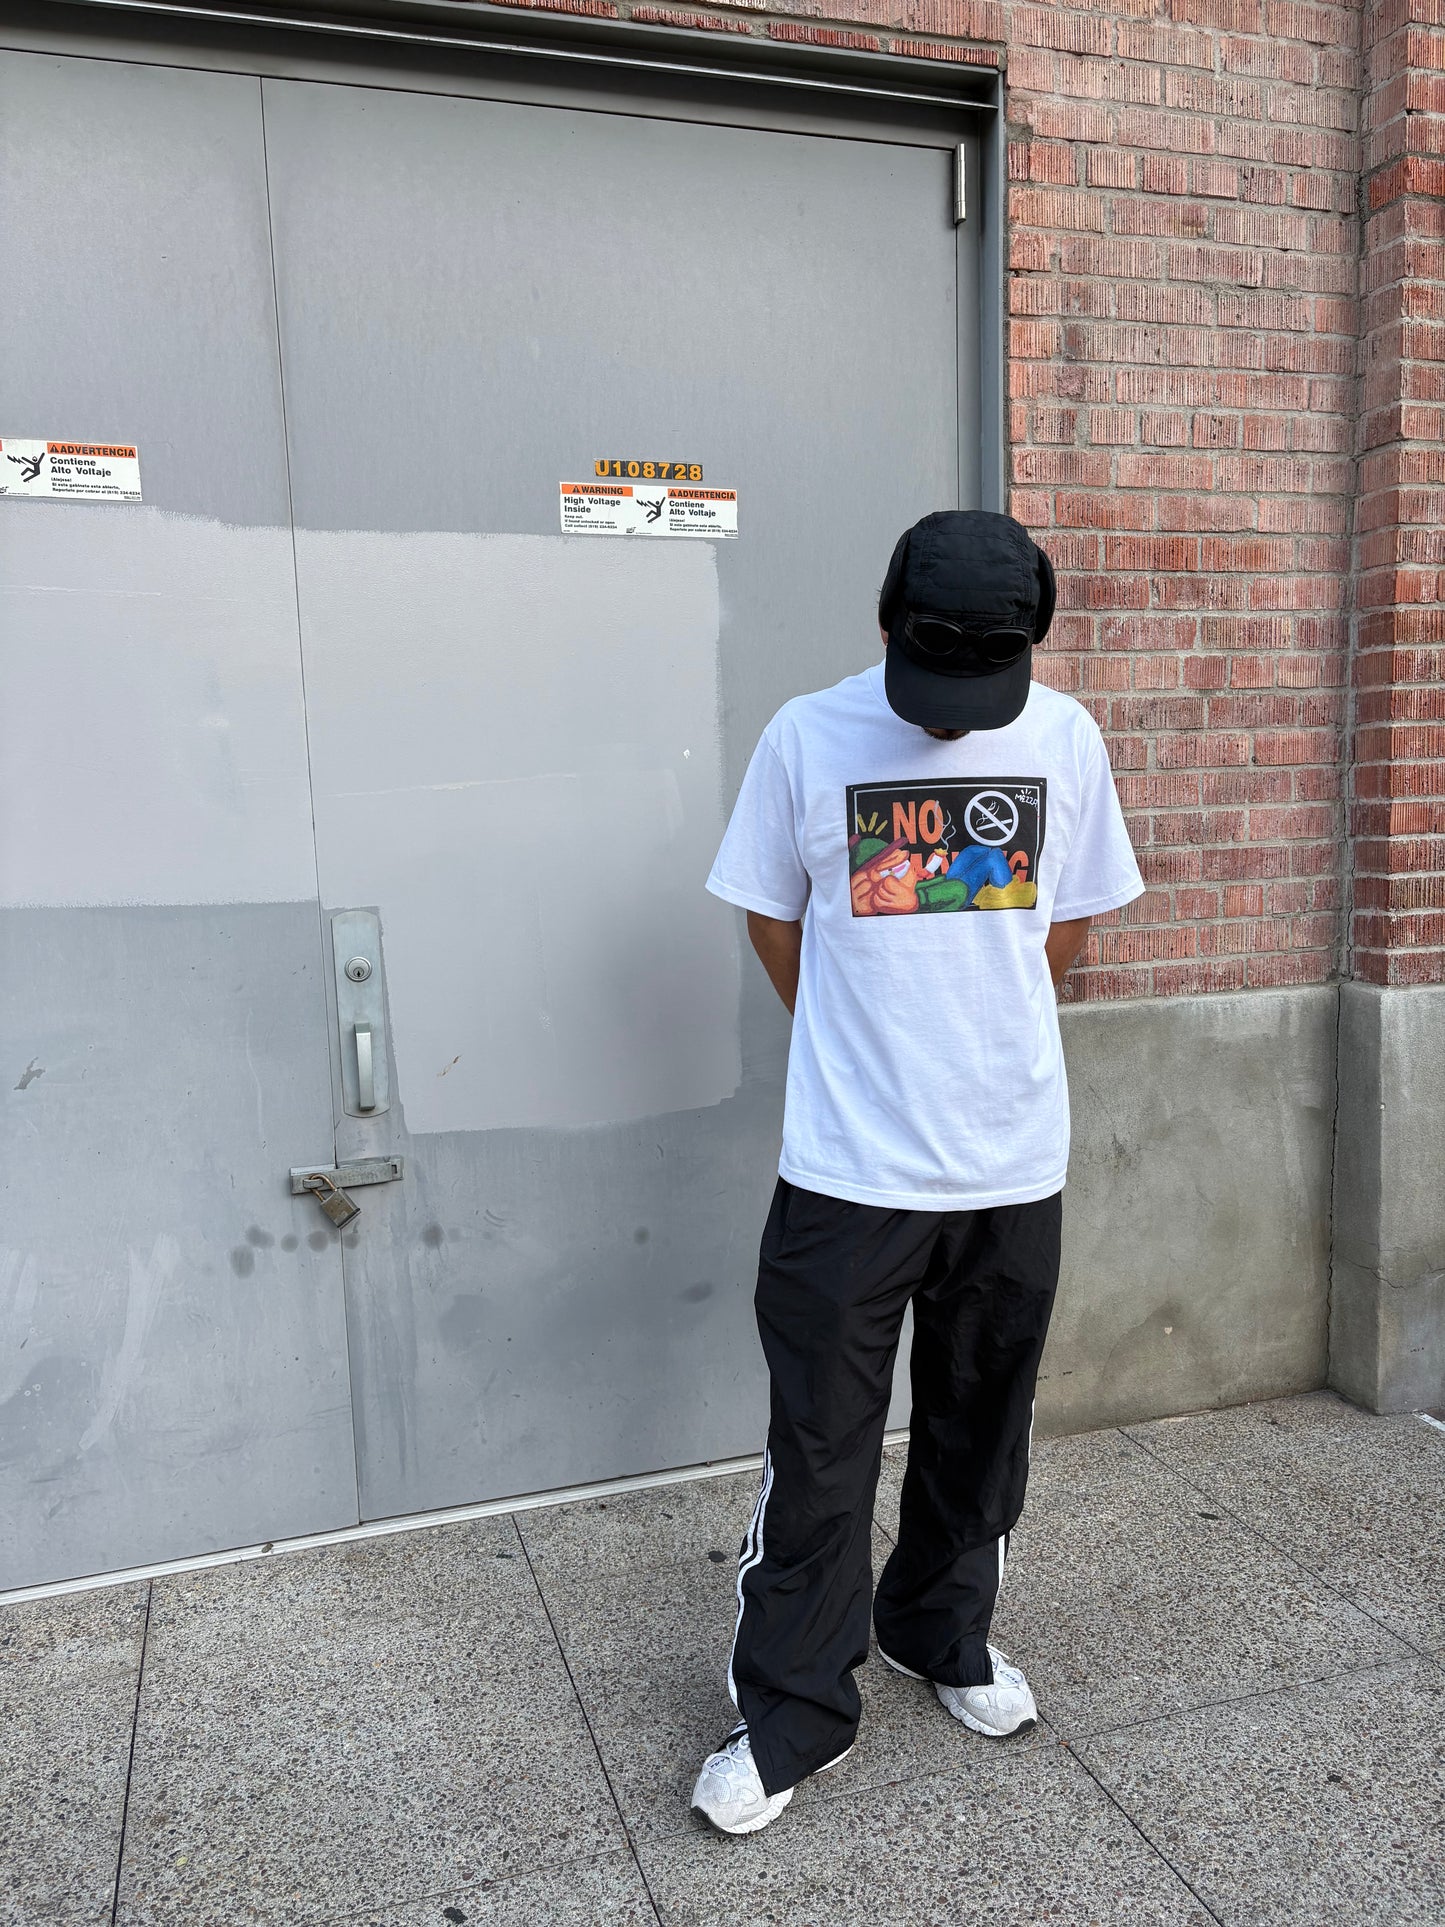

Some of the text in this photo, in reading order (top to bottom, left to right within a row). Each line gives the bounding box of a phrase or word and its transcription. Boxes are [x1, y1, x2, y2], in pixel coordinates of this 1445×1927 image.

[60, 445, 135, 457] ADVERTENCIA
[50, 456, 96, 466] Contiene
[51, 466, 112, 477] Alto Voltaje
[594, 460, 703, 481] U108728
[581, 486, 624, 495] WARNING
[677, 490, 736, 500] ADVERTENCIA
[564, 496, 621, 507] High Voltage
[669, 500, 705, 508] Contiene
[564, 505, 591, 513] Inside
[669, 508, 716, 518] Alto Voltaje
[891, 799, 944, 845] NO
